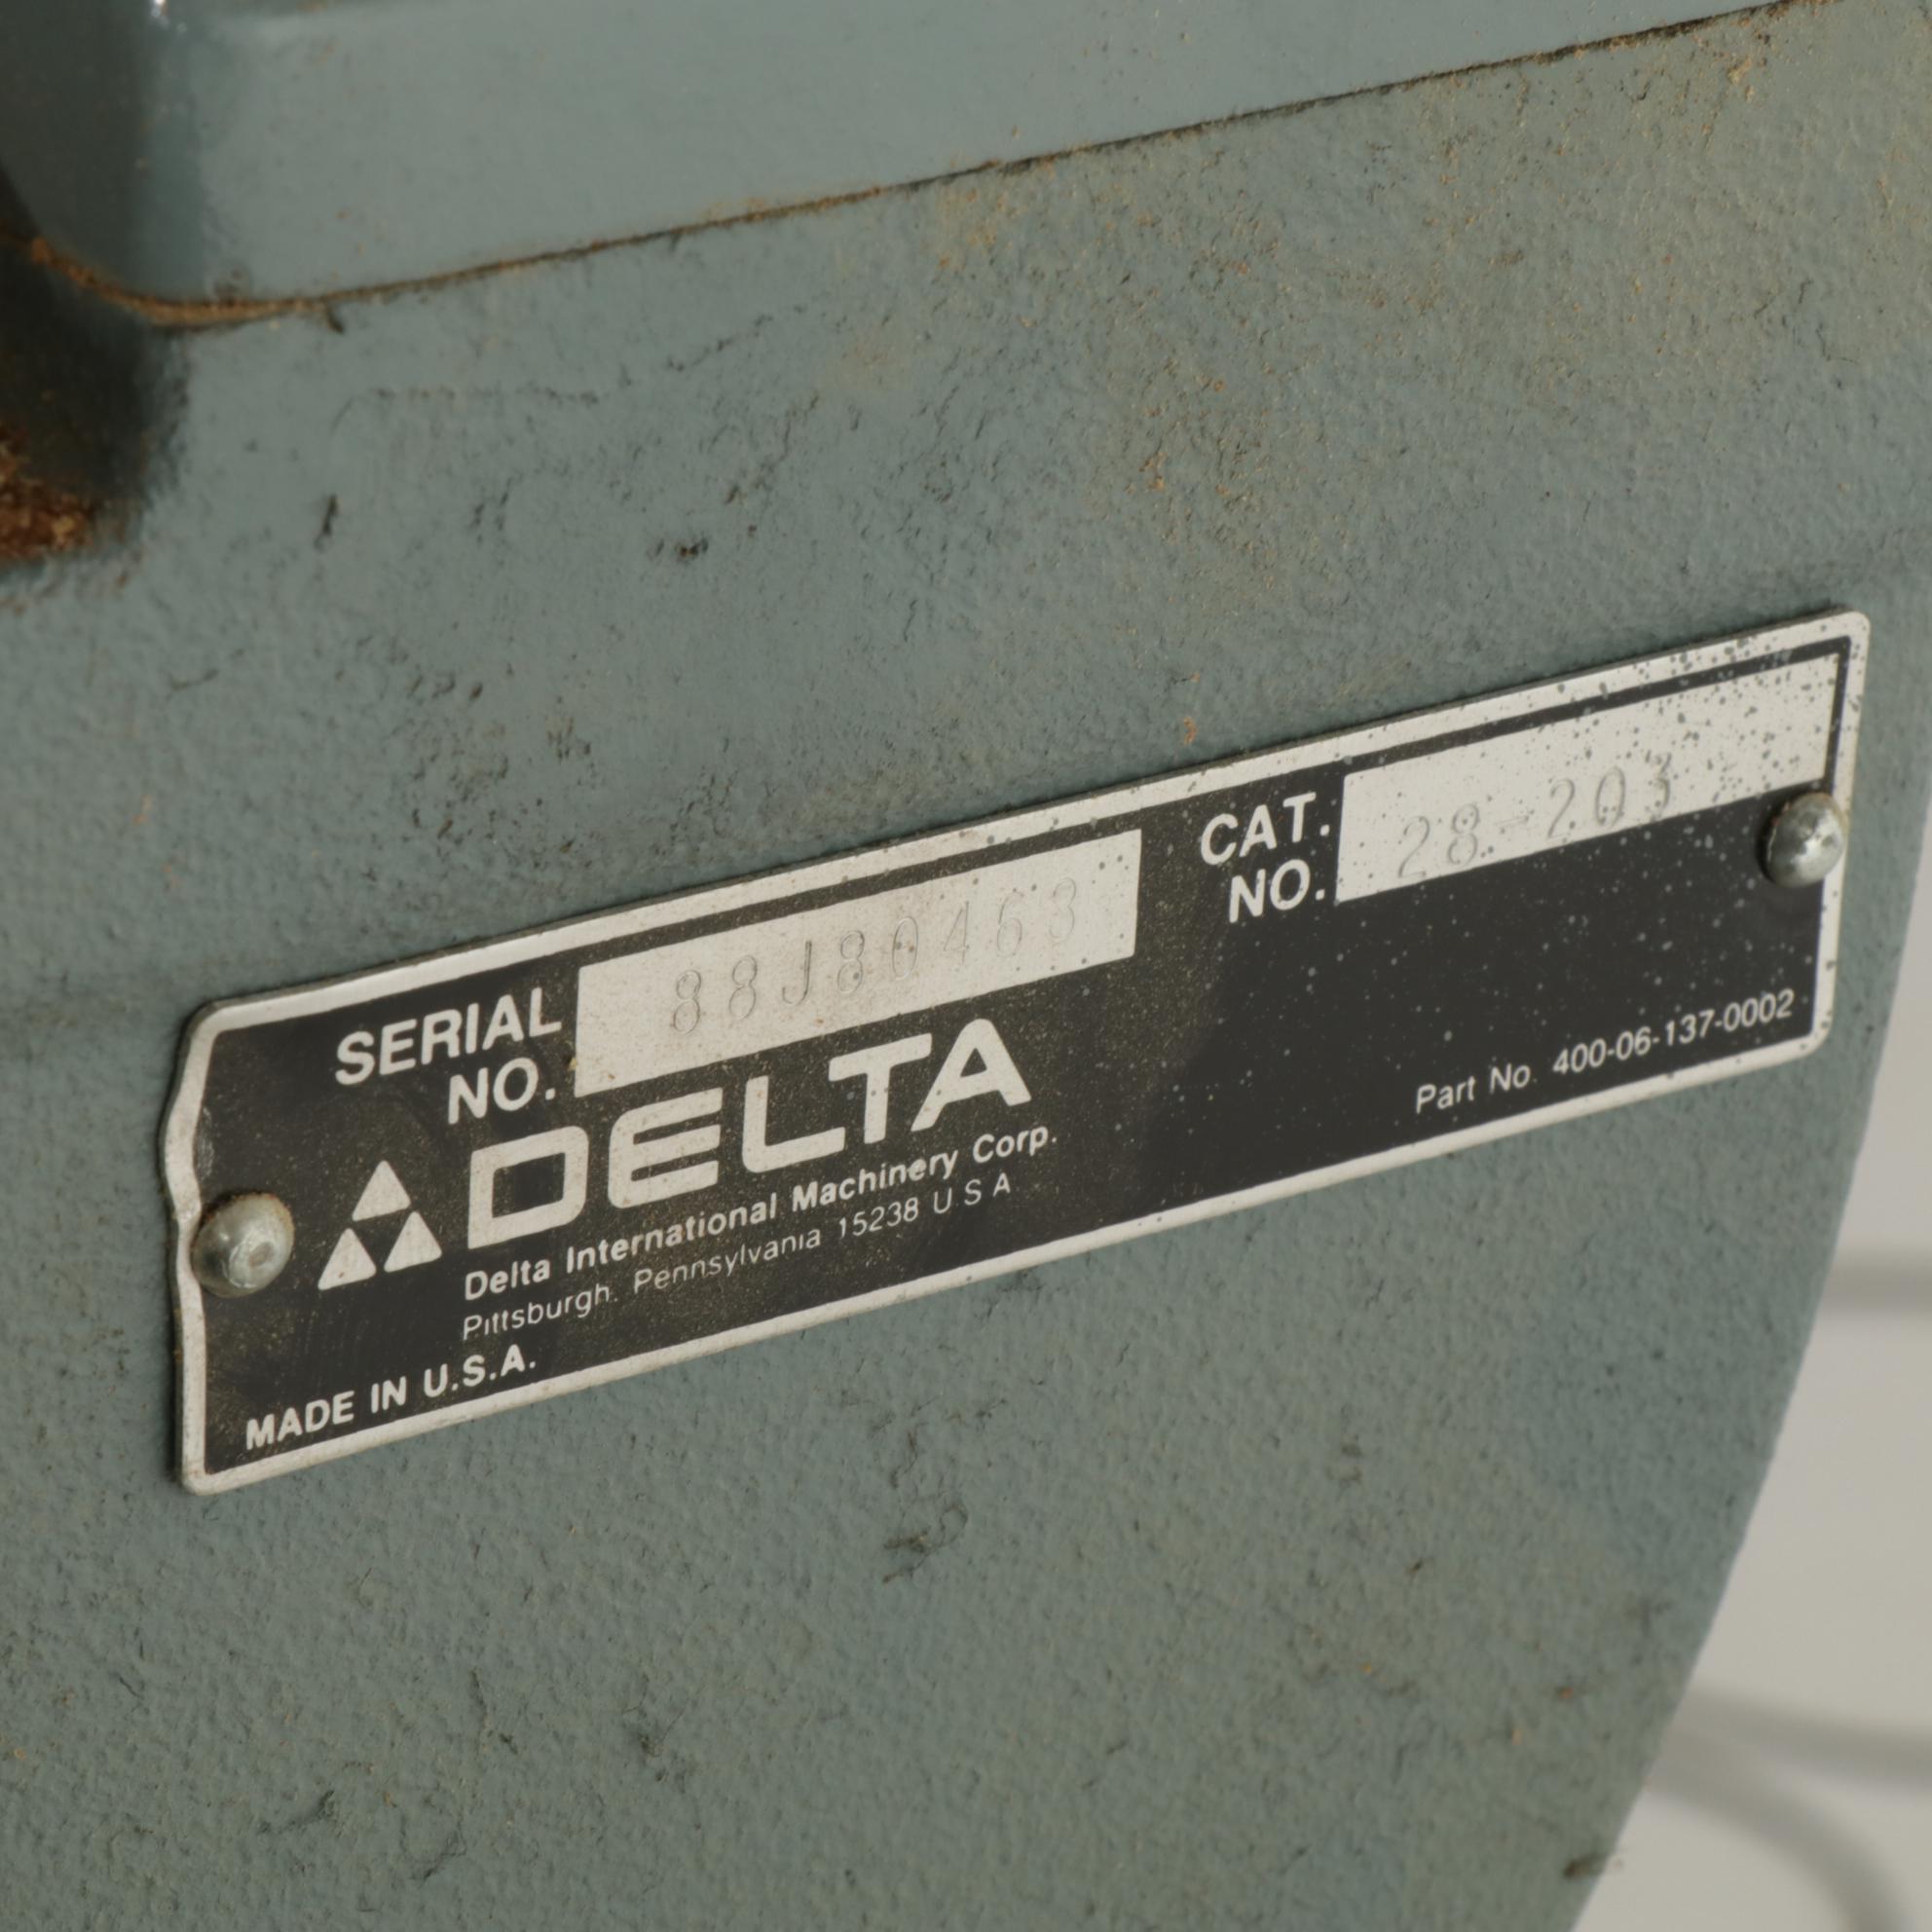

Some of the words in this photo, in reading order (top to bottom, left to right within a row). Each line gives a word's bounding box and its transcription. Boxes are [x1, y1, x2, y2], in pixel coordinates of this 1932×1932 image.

[1201, 793, 1330, 865] CAT.
[1228, 859, 1326, 924] NO.
[336, 987, 562, 1085] SERIAL
[1415, 1077, 1474, 1114] Part
[1554, 988, 1795, 1075] 400-06-137-0002
[447, 1058, 555, 1124] NO.
[467, 1019, 1032, 1249] DELTA
[464, 1258, 551, 1301] Delta
[567, 1193, 777, 1273] International
[792, 1150, 958, 1211] Machinery
[974, 1126, 1058, 1164] Corp.
[634, 1229, 821, 1294] Pennsylvania
[838, 1198, 919, 1240] 15238
[245, 1391, 354, 1449] MADE
[370, 1376, 407, 1414] IN
[423, 1344, 537, 1397] U.S.A.
